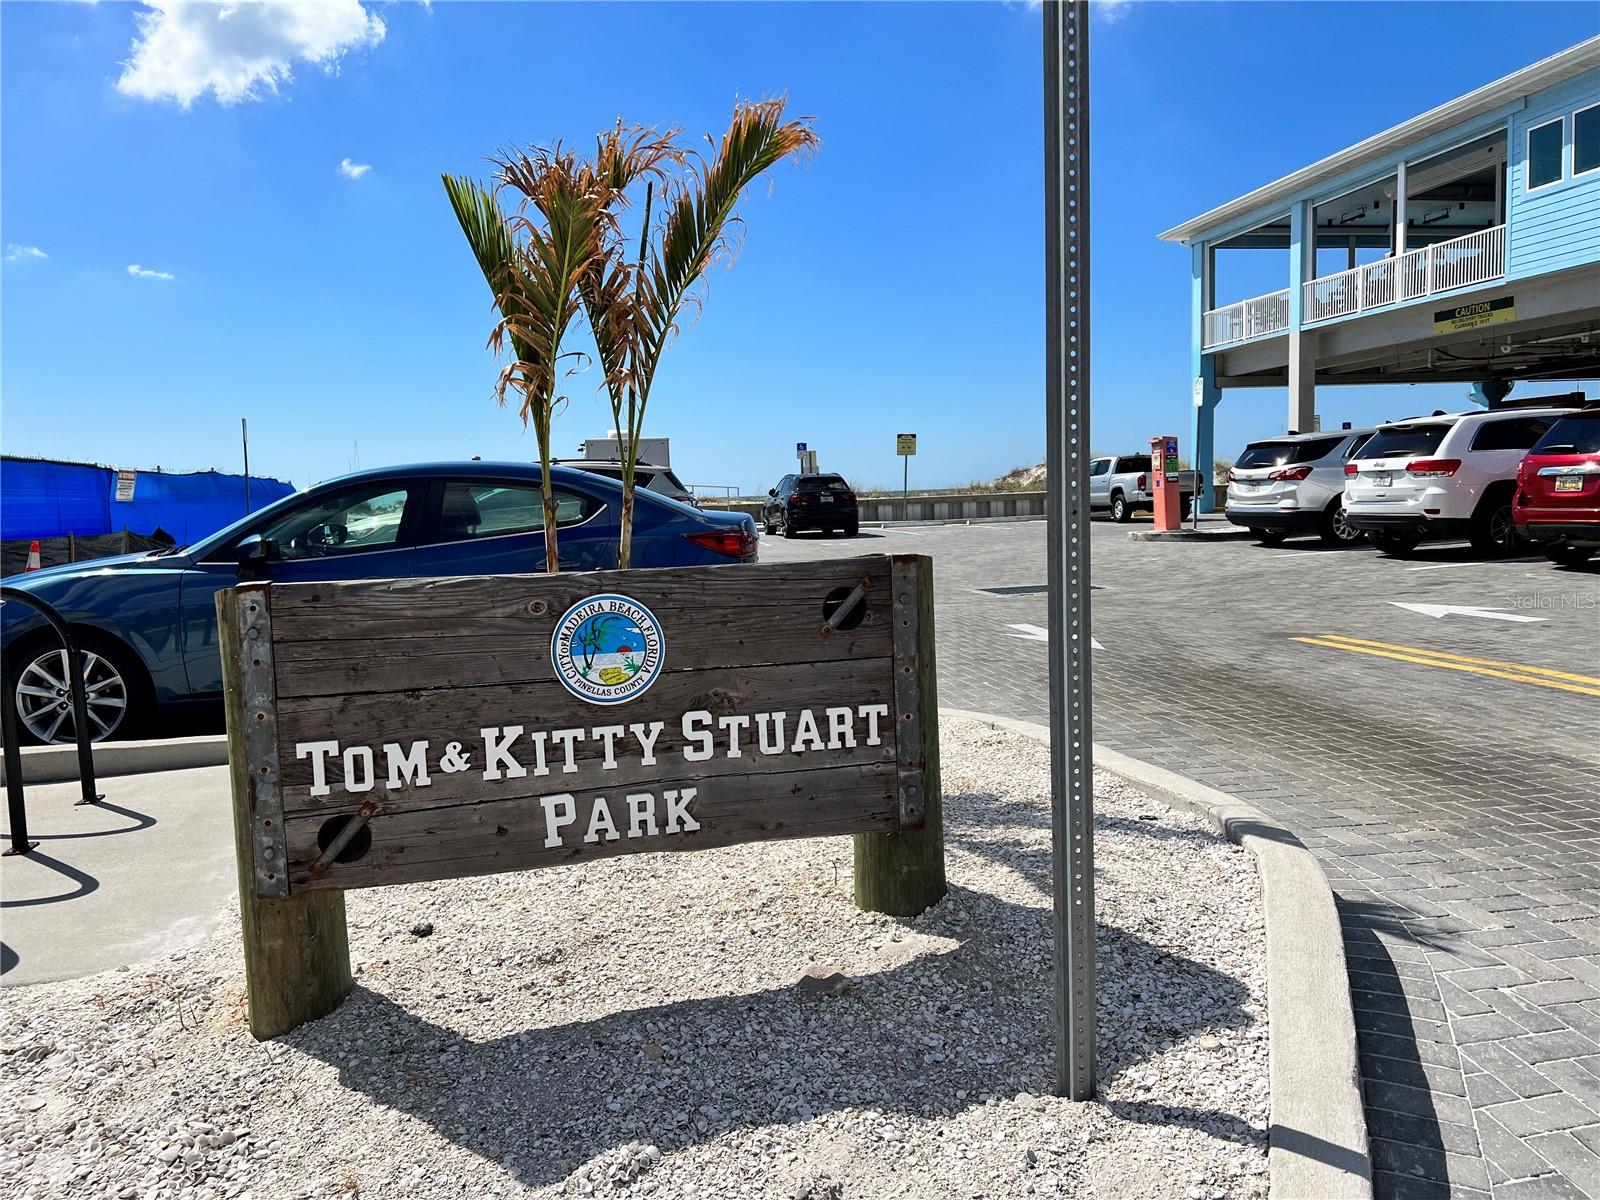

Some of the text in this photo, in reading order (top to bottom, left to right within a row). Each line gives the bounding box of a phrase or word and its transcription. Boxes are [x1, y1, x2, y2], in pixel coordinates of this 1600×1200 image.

[1455, 302, 1490, 318] CAUTION
[560, 602, 604, 644] MADEIRA
[559, 653, 576, 679] CITY
[641, 625, 659, 674] FLORIDA
[574, 676, 645, 696] PINELLAS COUNTY
[439, 741, 471, 774] &
[540, 787, 701, 848] PARK
